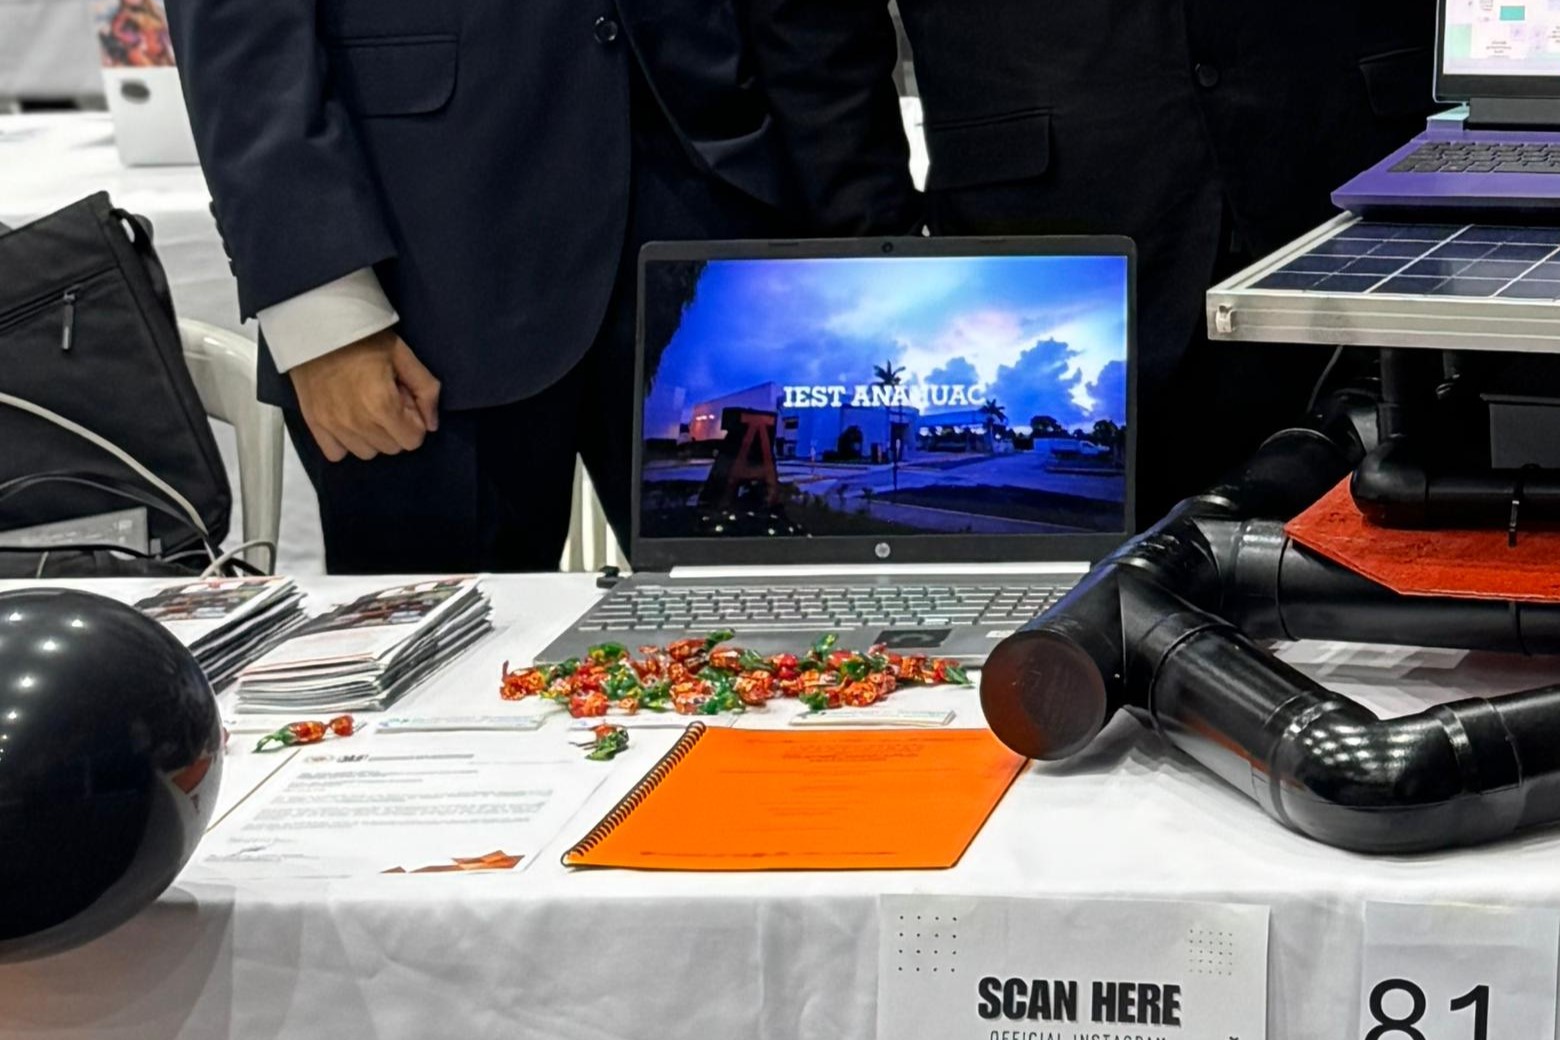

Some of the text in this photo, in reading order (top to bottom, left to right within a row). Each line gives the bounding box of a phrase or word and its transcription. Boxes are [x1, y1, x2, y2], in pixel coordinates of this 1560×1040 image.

[783, 386, 846, 408] IEST
[977, 976, 1182, 1027] SCAN HERE
[1364, 978, 1490, 1040] 81
